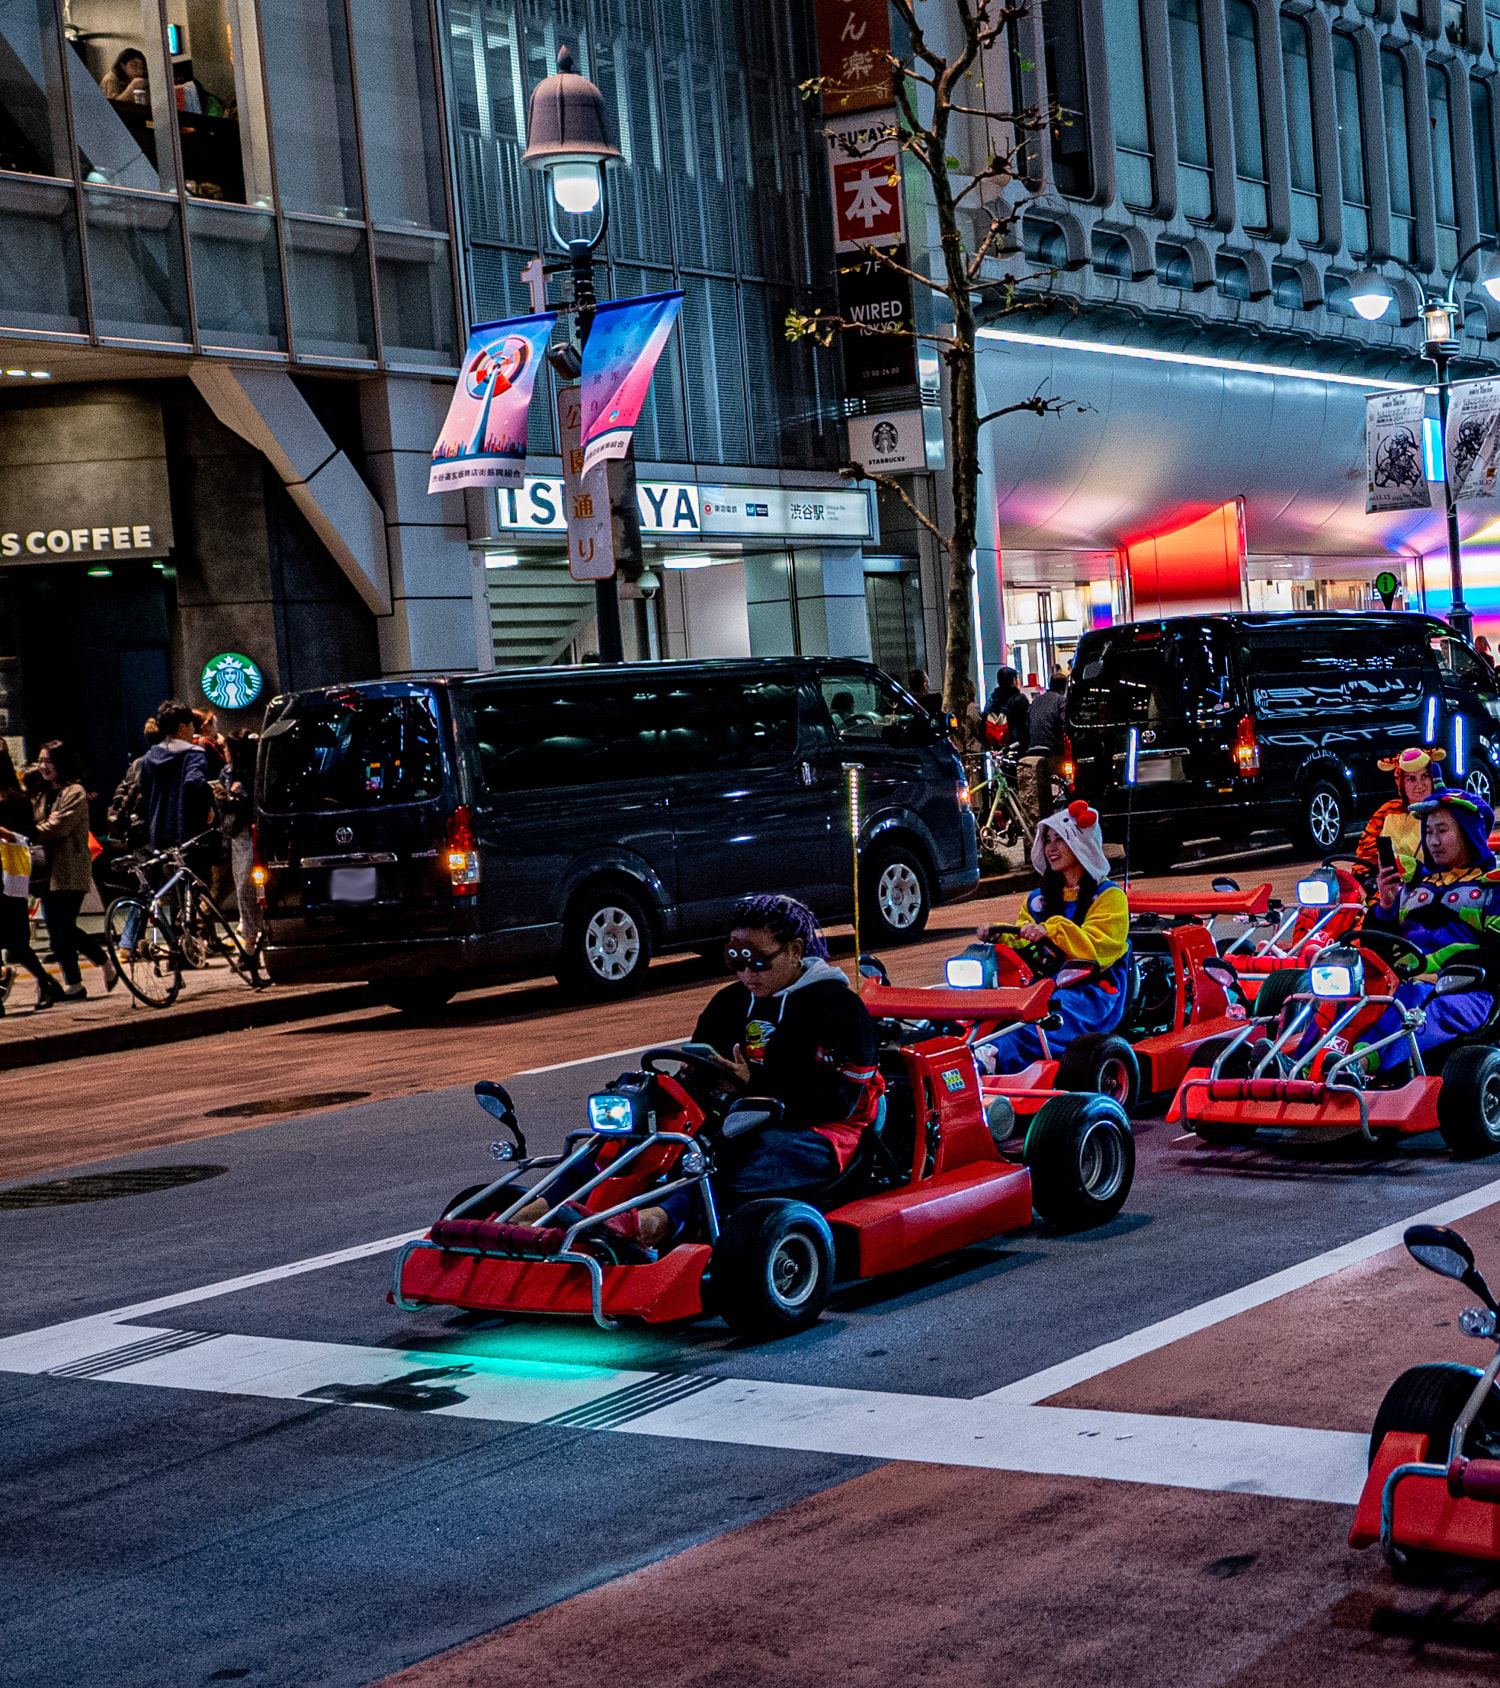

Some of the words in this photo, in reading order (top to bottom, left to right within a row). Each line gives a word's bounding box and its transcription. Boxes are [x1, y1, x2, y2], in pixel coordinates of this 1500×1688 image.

[843, 169, 893, 229] 本
[850, 300, 903, 322] WIRED
[868, 456, 906, 466] STARBUCKS
[504, 482, 699, 529] TSYA
[790, 504, 825, 521] 渋谷駅
[26, 525, 151, 554] COFFEE
